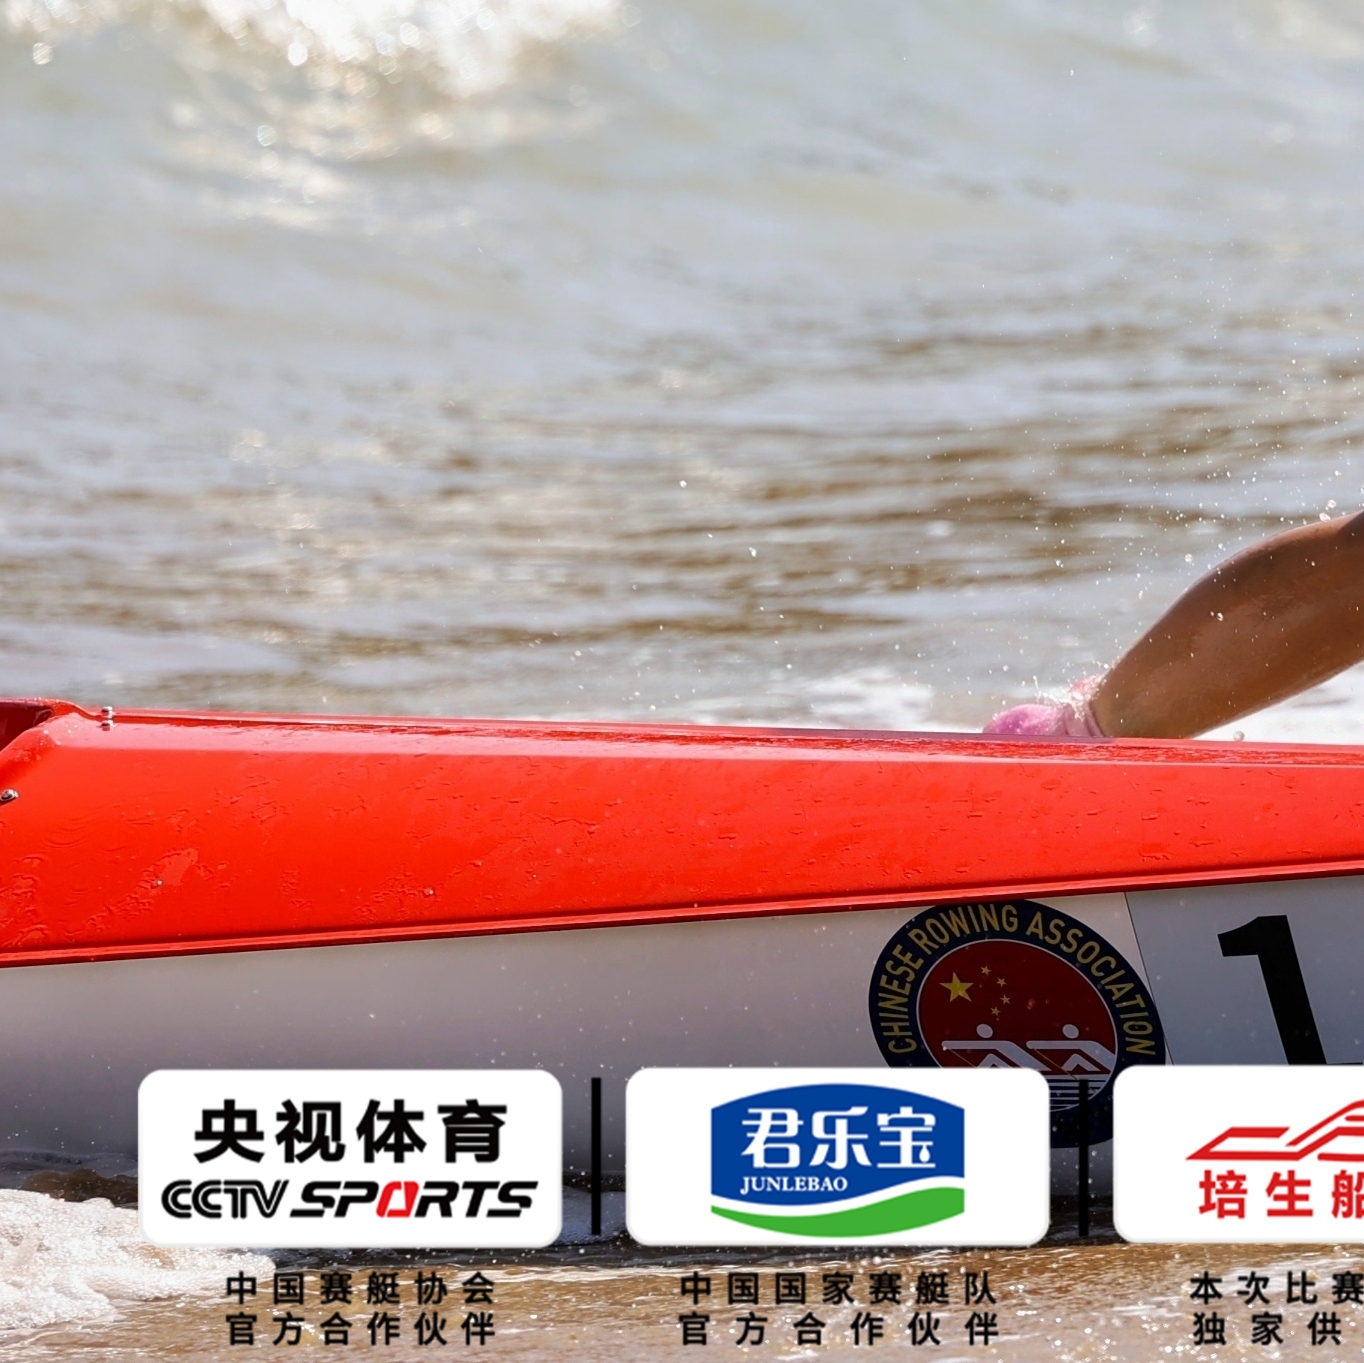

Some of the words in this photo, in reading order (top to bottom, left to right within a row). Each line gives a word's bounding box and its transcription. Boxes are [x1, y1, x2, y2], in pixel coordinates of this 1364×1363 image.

[877, 944, 925, 1054] CHINESE
[907, 903, 1019, 956] ROWING
[1025, 911, 1156, 1056] ASSOCIATION
